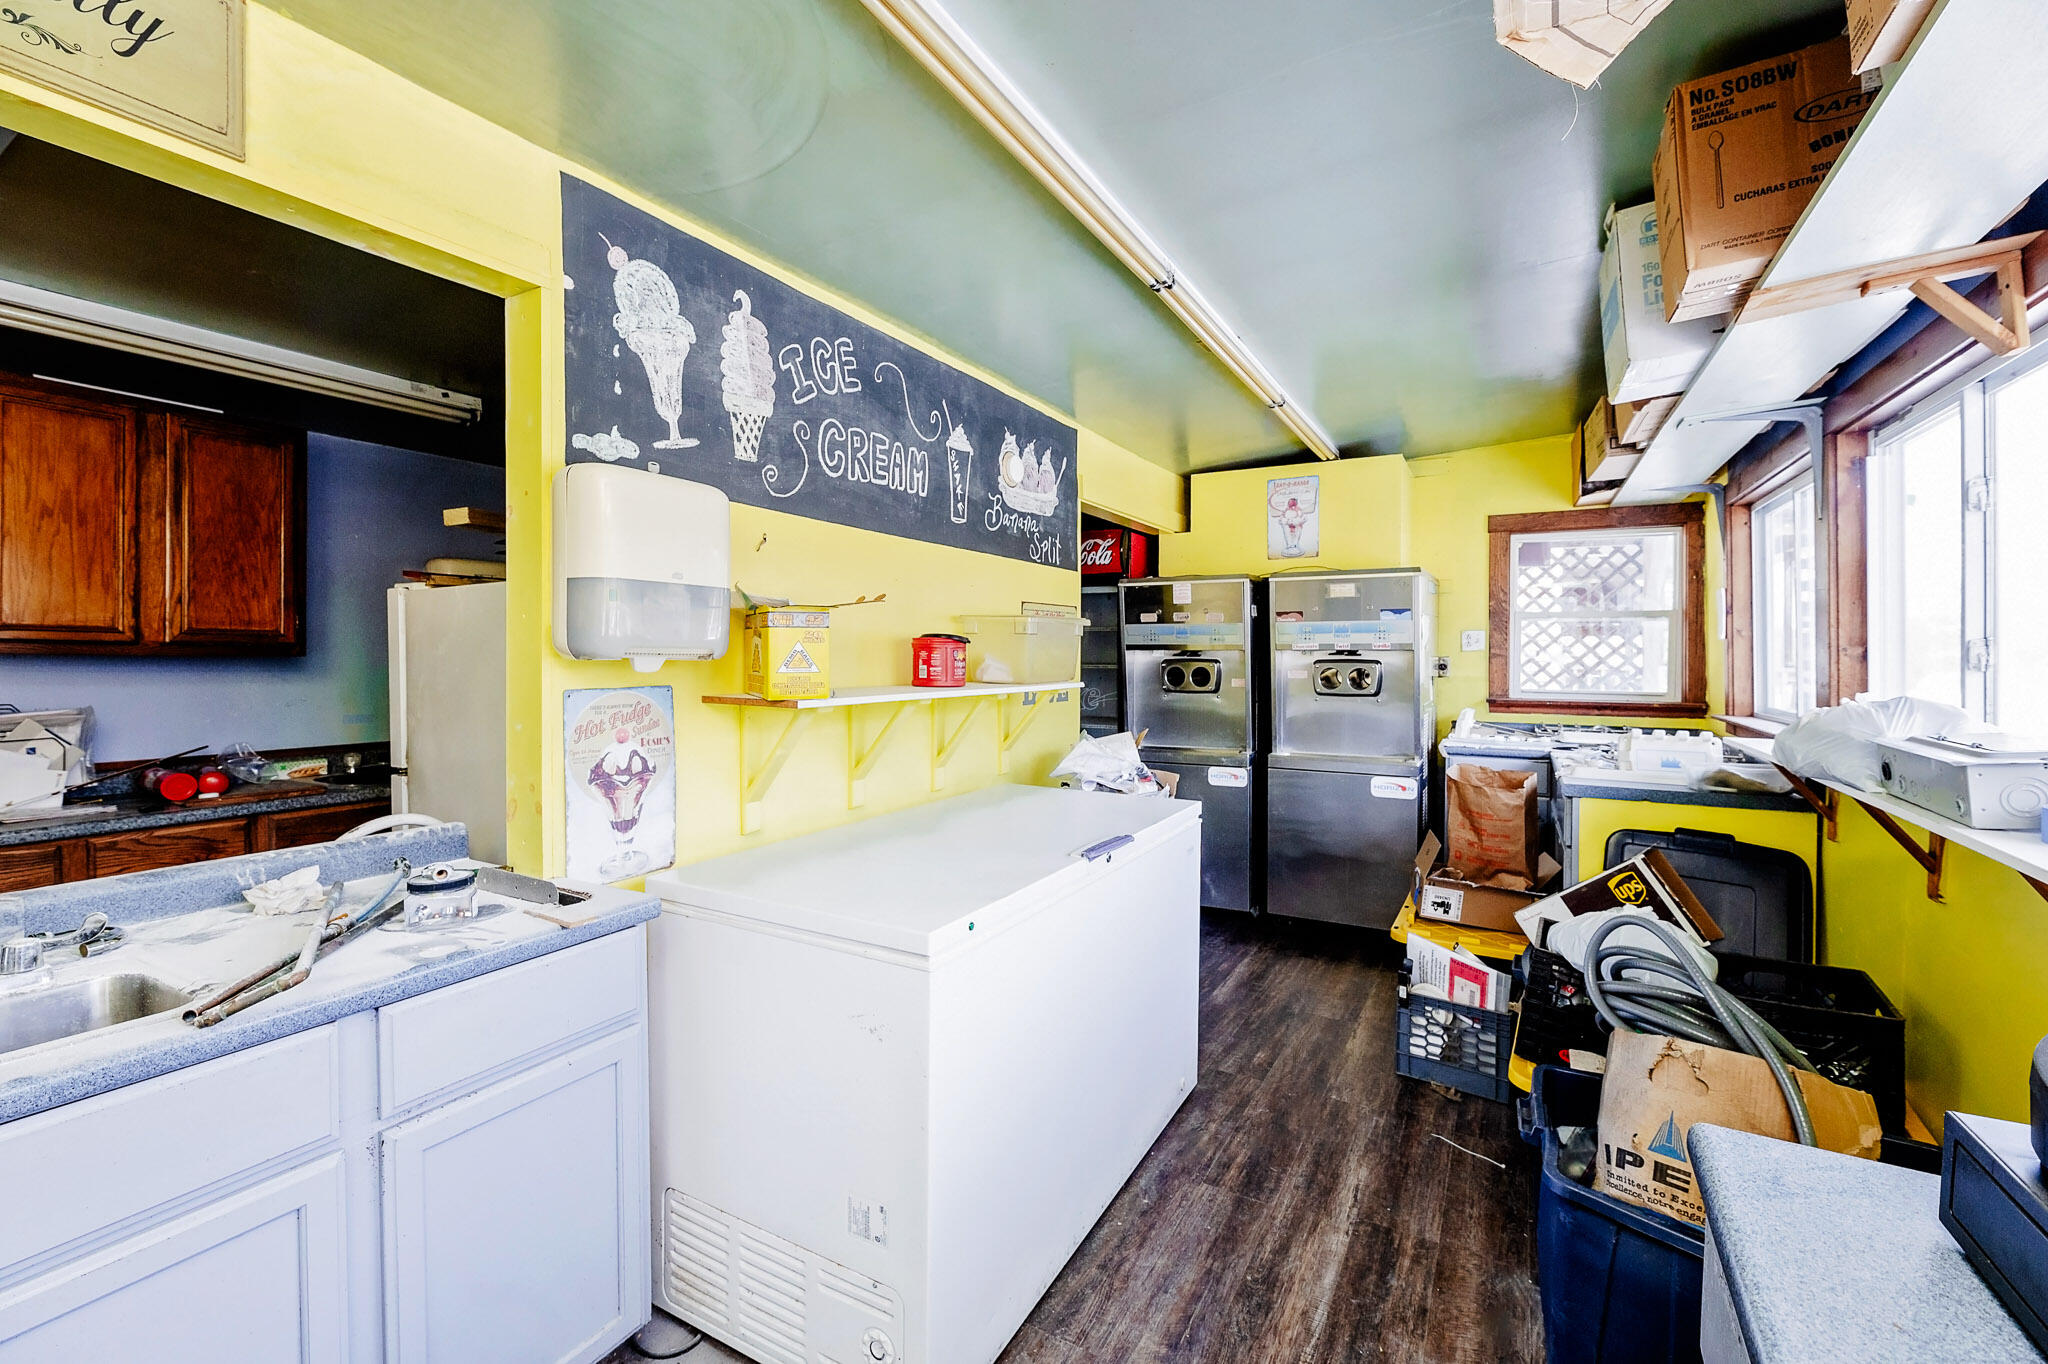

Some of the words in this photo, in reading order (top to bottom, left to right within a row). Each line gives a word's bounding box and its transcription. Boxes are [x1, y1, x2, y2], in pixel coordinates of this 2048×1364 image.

[1689, 88, 1719, 107] No.
[1755, 101, 1777, 113] VRAC
[1733, 182, 1786, 203] CUCHARAS
[1788, 175, 1820, 190] EXTRA
[779, 337, 862, 405] ICE
[984, 492, 1040, 537] Banana
[1029, 532, 1062, 565] Split
[574, 719, 606, 745] Hot
[609, 700, 652, 729] Fudge
[1613, 879, 1644, 901] ups
[1653, 1187, 1667, 1199] to
[1670, 1193, 1706, 1213] Exce
